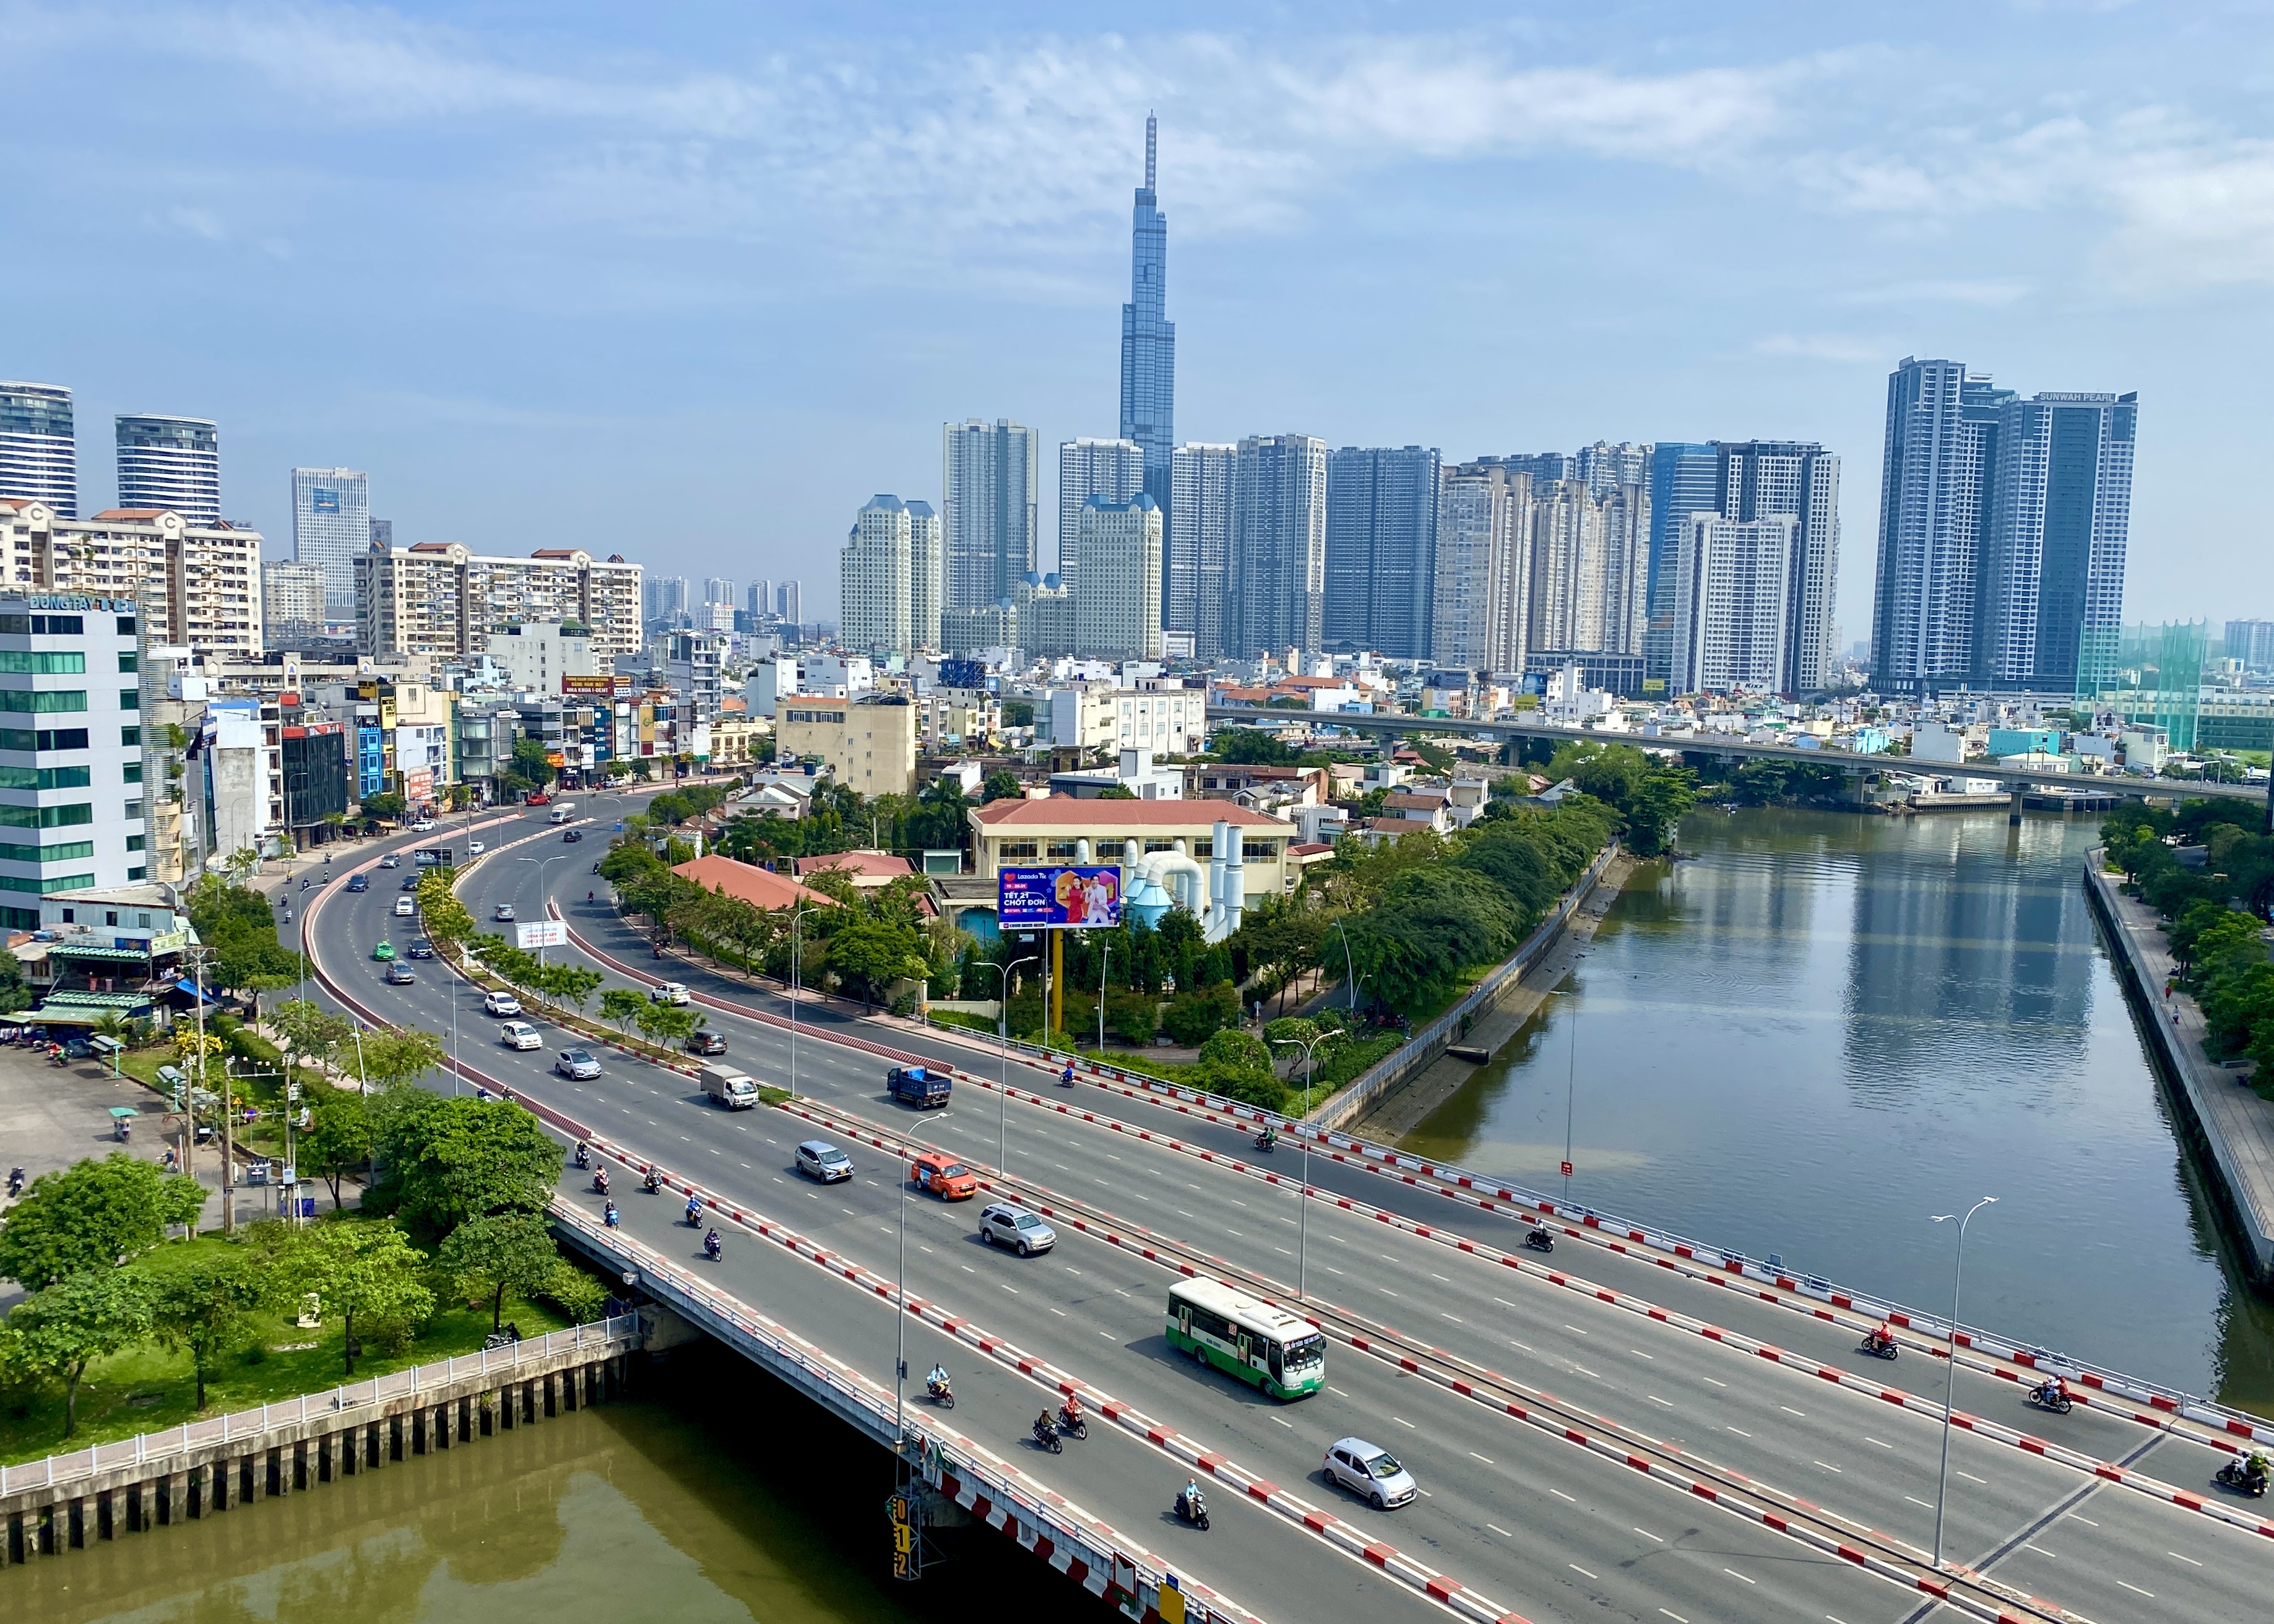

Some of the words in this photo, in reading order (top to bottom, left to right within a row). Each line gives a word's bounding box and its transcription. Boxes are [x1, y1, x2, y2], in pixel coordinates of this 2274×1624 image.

[2083, 393, 2114, 401] PEARL
[31, 508, 43, 520] C
[165, 517, 176, 529] C
[454, 548, 464, 557] C
[577, 555, 586, 565] C
[897, 1499, 906, 1519] 0
[898, 1527, 904, 1548] 1
[898, 1554, 906, 1575] 2
